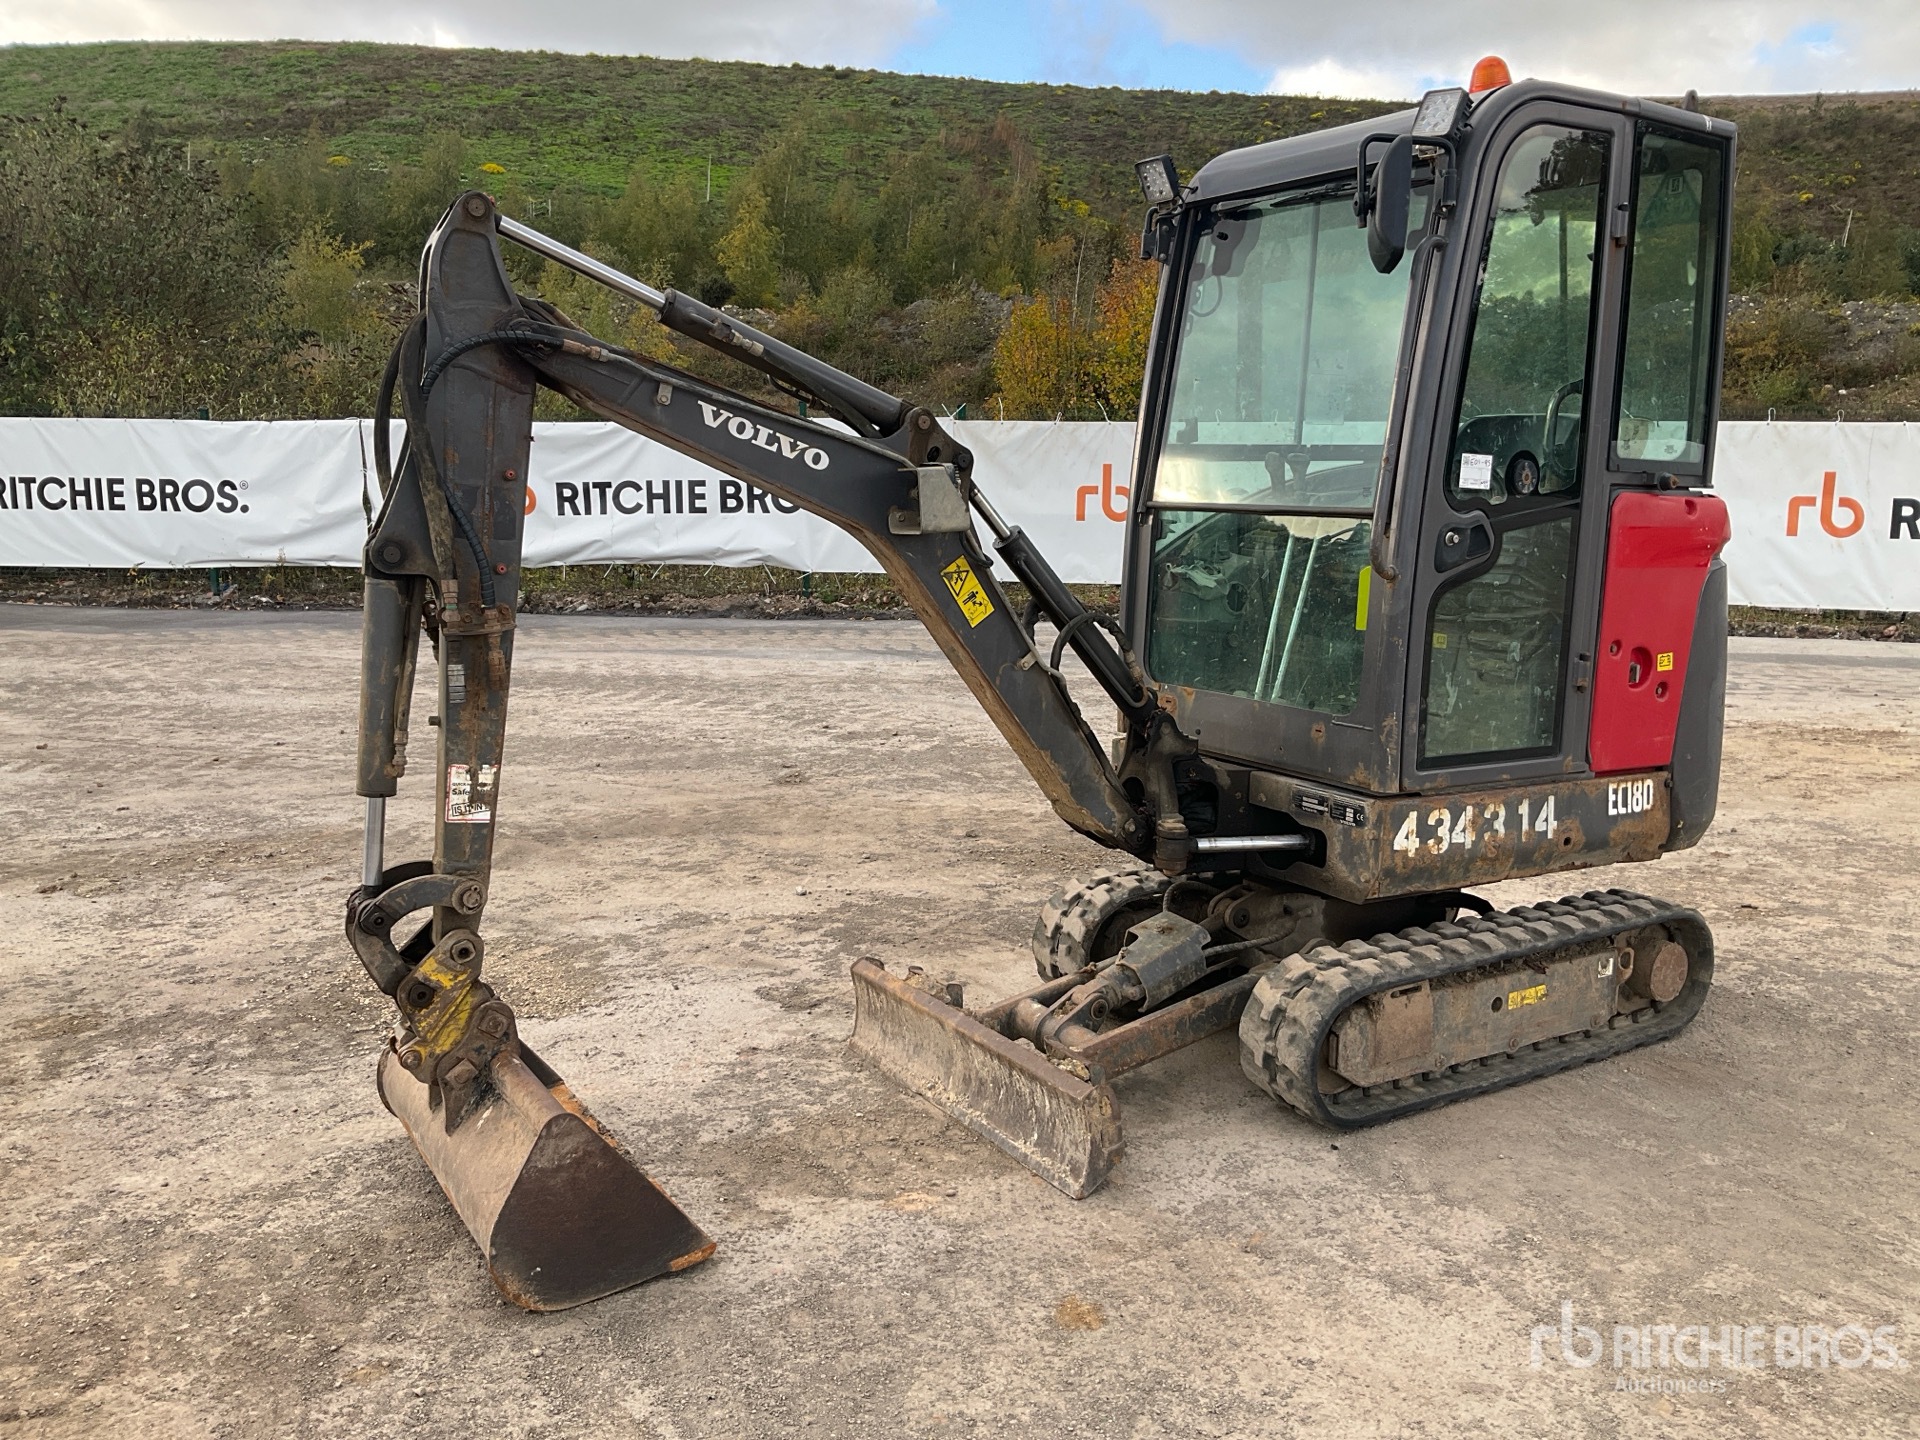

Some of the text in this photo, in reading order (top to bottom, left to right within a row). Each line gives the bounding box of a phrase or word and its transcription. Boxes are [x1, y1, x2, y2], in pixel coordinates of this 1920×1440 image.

[698, 400, 830, 471] VOLVO
[555, 479, 708, 516] RITCHIE
[1786, 471, 1865, 538] rb
[1608, 778, 1653, 816] EC18D
